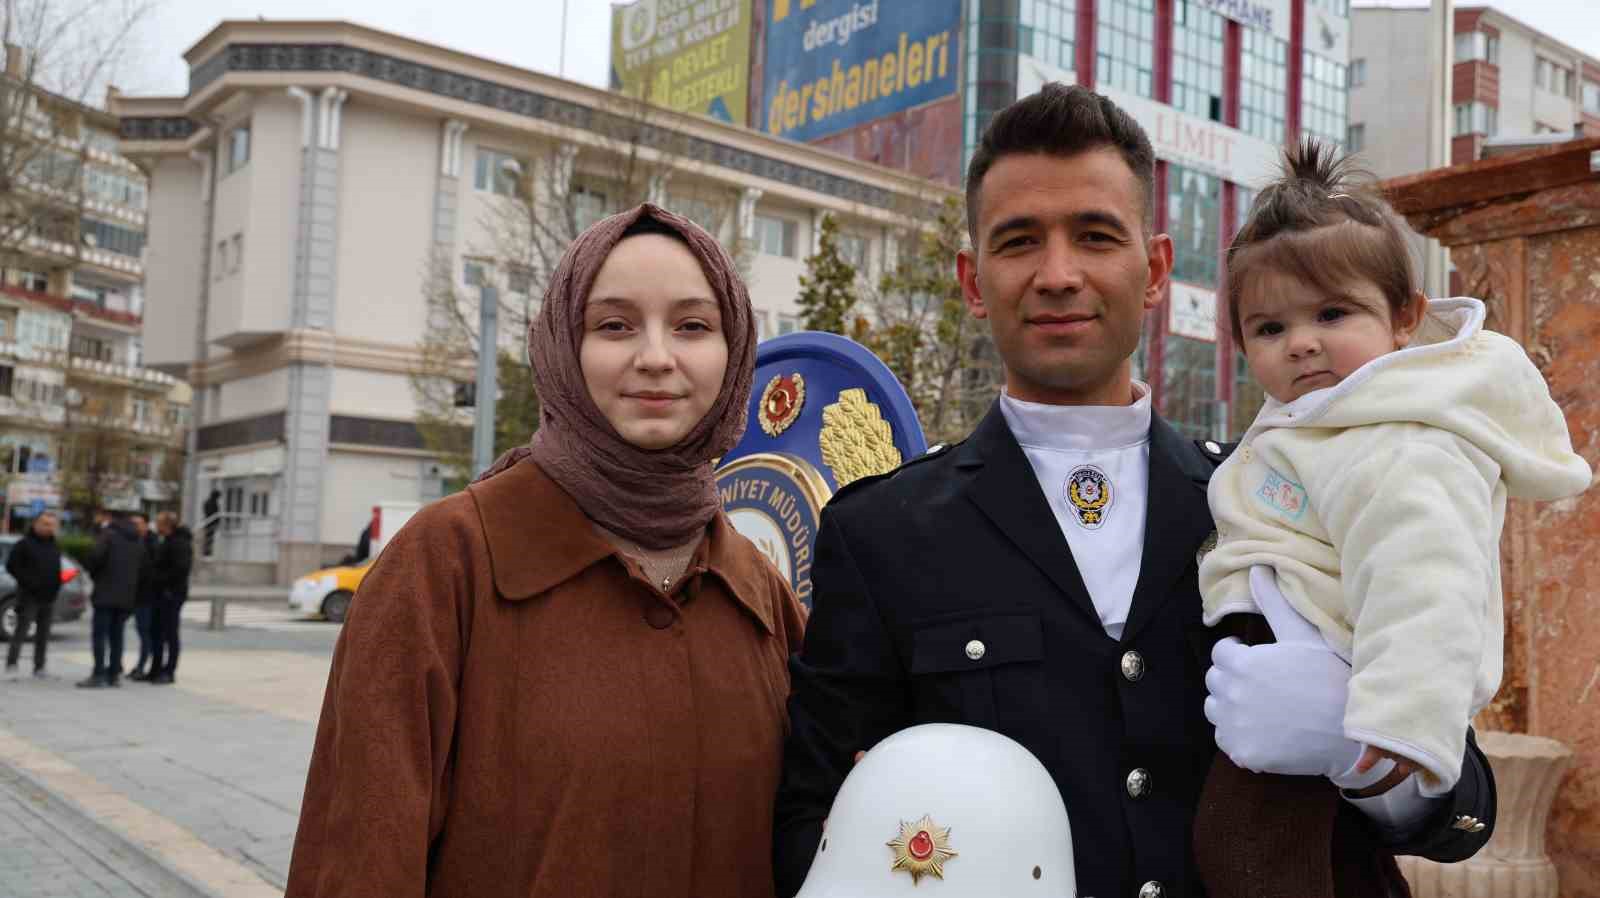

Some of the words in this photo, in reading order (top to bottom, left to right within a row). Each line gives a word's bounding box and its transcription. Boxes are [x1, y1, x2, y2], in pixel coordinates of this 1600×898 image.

[803, 0, 880, 52] dergisi
[768, 31, 949, 136] dershaneleri
[720, 477, 770, 506] NİYET
[768, 485, 814, 601] MÜDÜRLÜ
